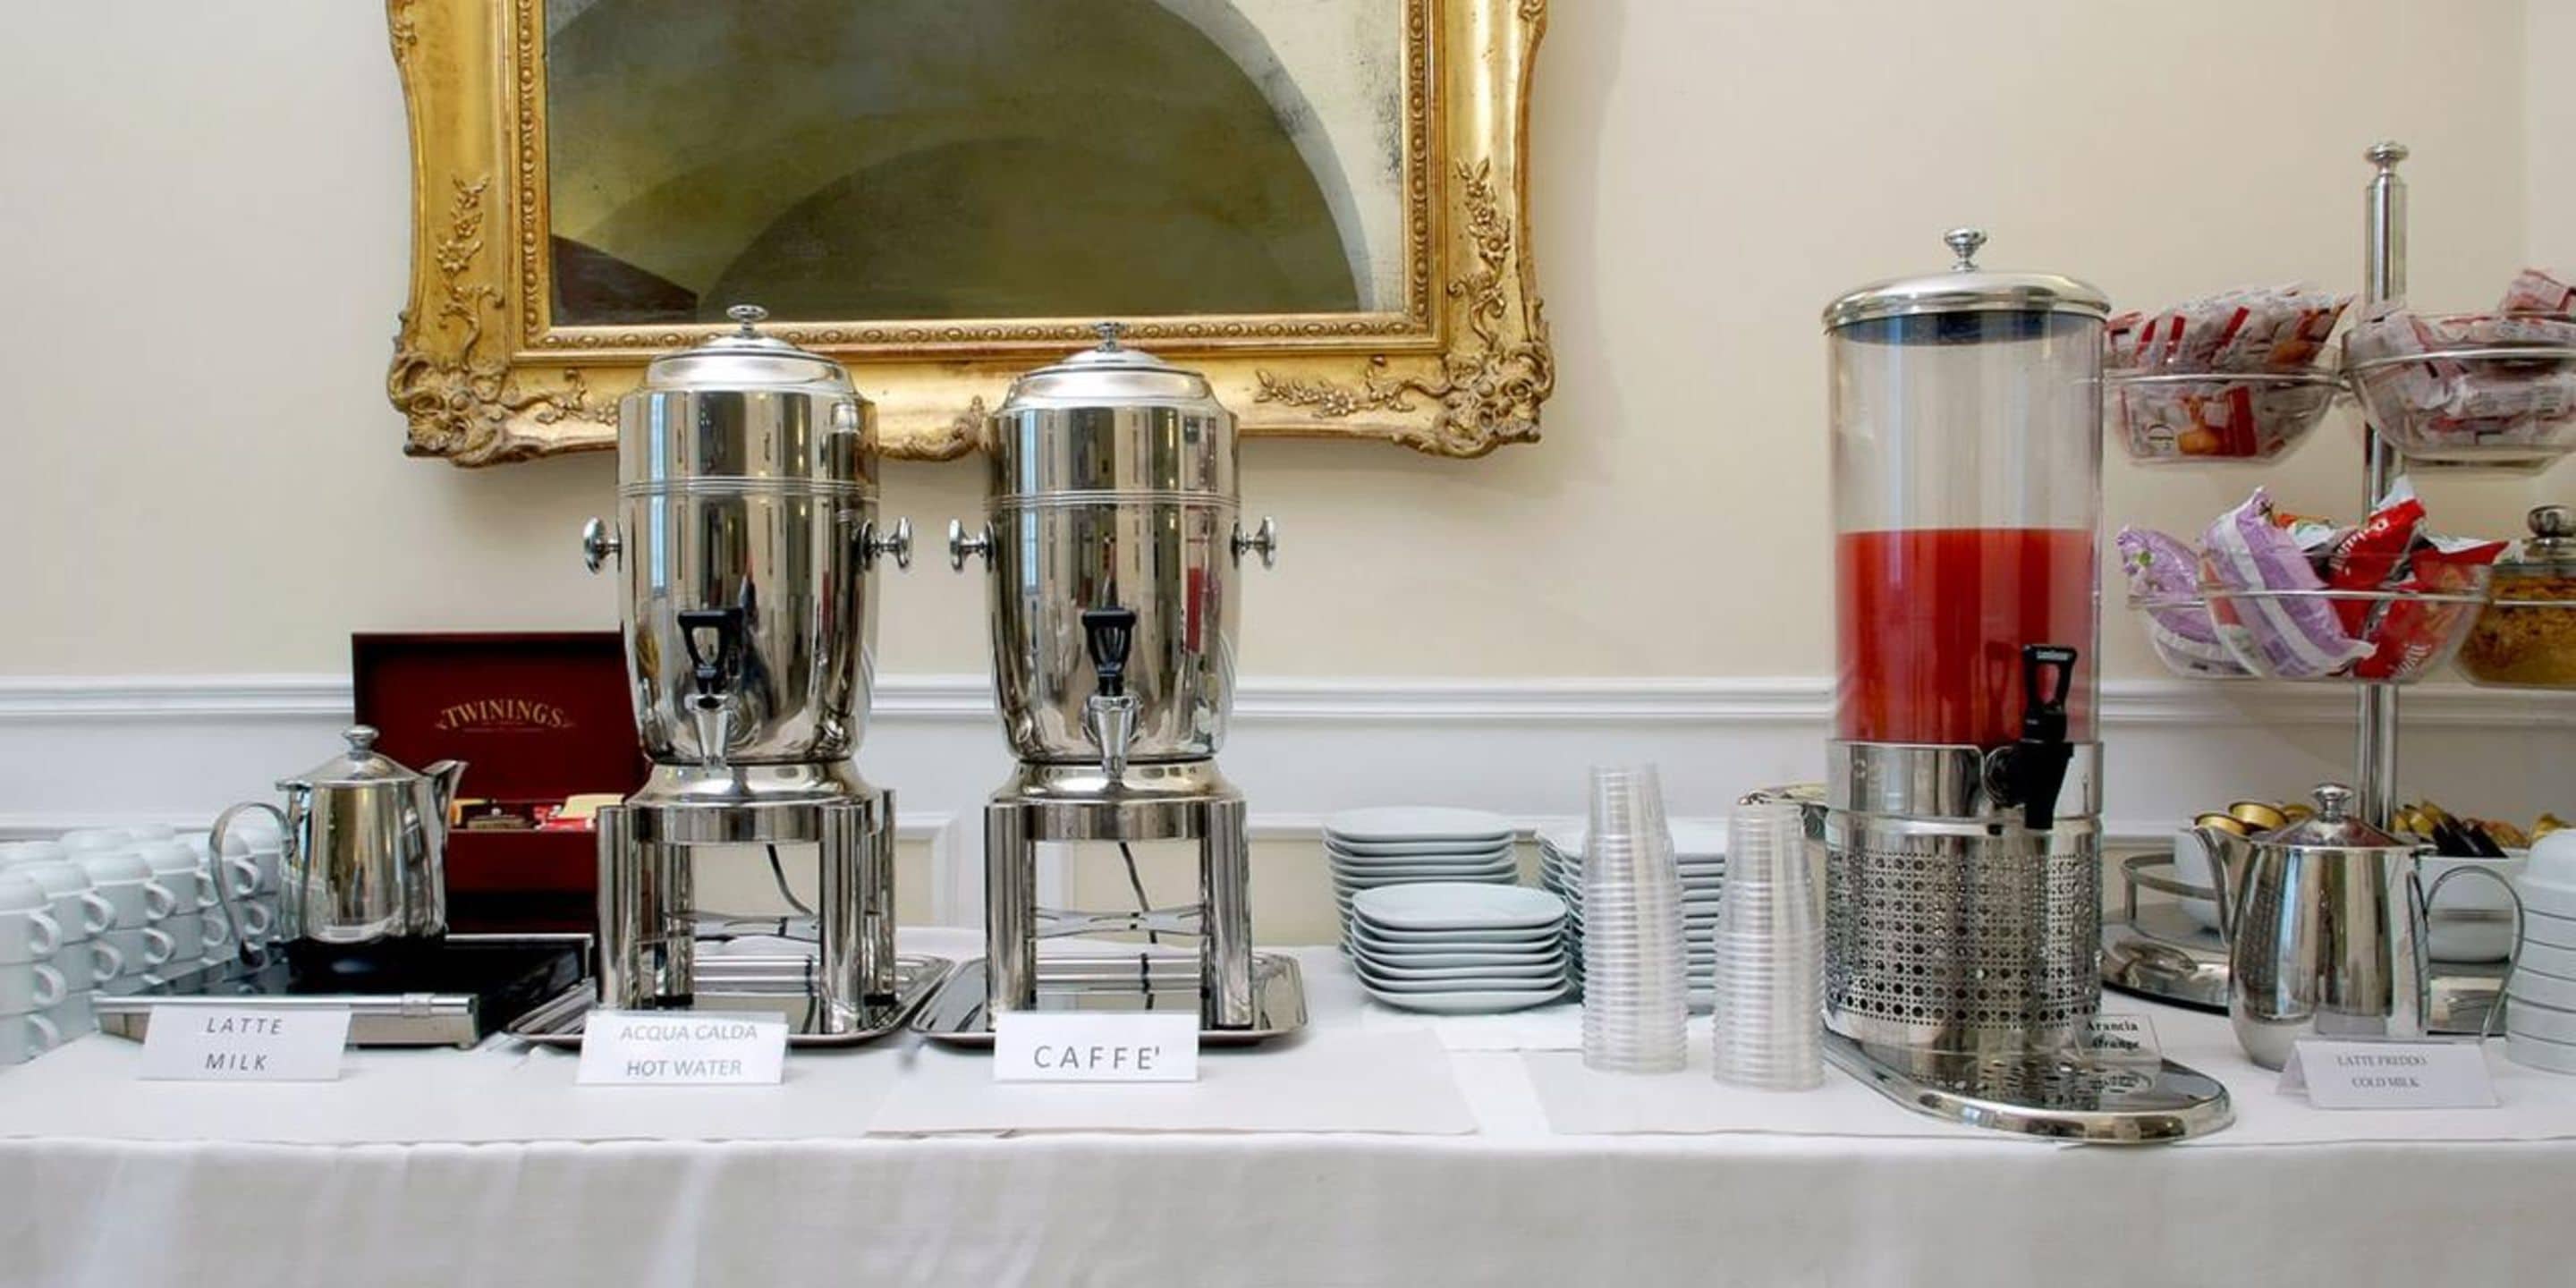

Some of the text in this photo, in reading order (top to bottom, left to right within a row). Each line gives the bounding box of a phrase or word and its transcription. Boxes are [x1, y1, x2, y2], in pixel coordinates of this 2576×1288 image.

[441, 699, 565, 729] TWININGS
[205, 1016, 284, 1035] LATTE
[620, 1024, 758, 1041] ACQUA CALDA
[2085, 1020, 2139, 1031] Arancia
[205, 1053, 268, 1072] MILK
[1034, 1046, 1160, 1070] CAFFE'
[2336, 1055, 2376, 1066] LATTE
[626, 1060, 742, 1077] HOT WATER
[2351, 1077, 2419, 1088] COLD MILK
